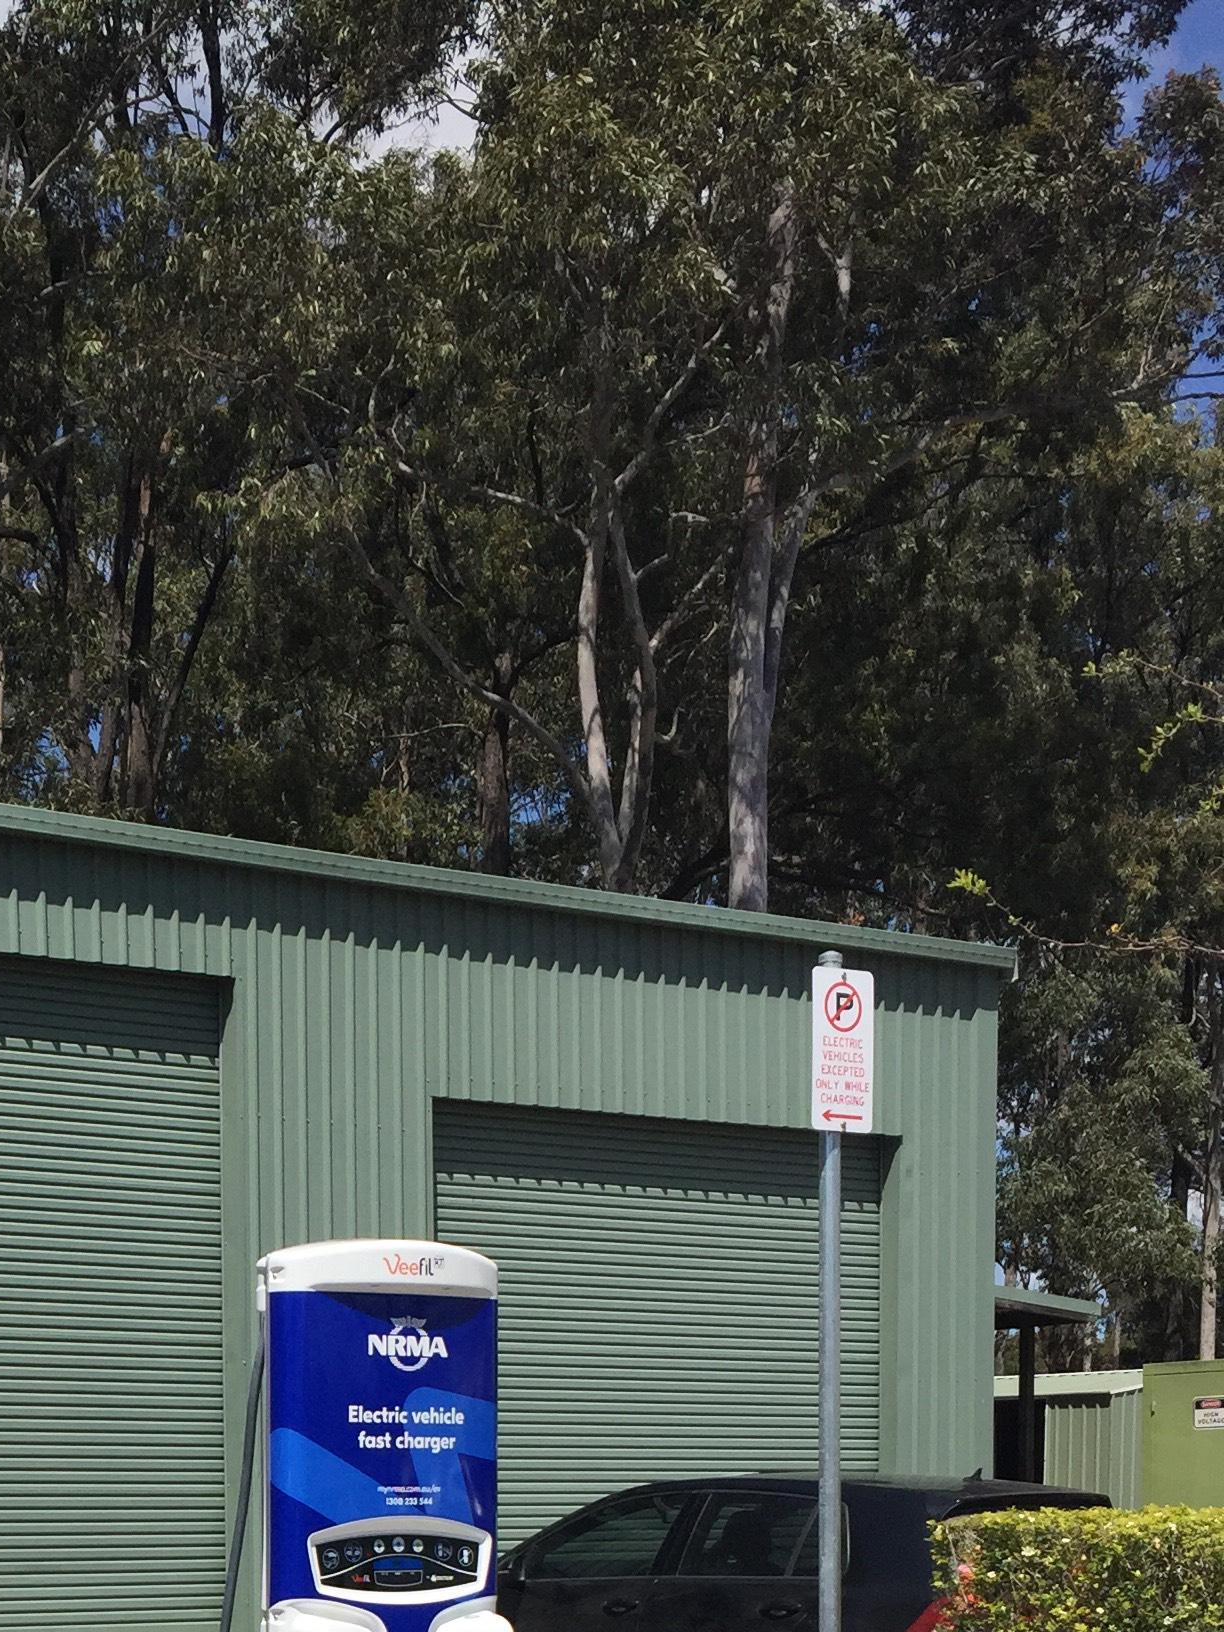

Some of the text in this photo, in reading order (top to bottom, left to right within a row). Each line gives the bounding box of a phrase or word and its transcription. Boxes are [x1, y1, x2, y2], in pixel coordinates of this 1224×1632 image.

[822, 1035, 863, 1049] ELECTRIC
[822, 1051, 864, 1064] VEHICLES
[821, 1064, 865, 1078] EXCEPTED
[815, 1078, 870, 1093] ONLY WHILE
[820, 1093, 864, 1106] CHARGING
[382, 1253, 434, 1276] Veefil
[367, 1334, 448, 1358] NRMA
[348, 1405, 464, 1425] Electric vehicle
[358, 1431, 456, 1453] fast charger
